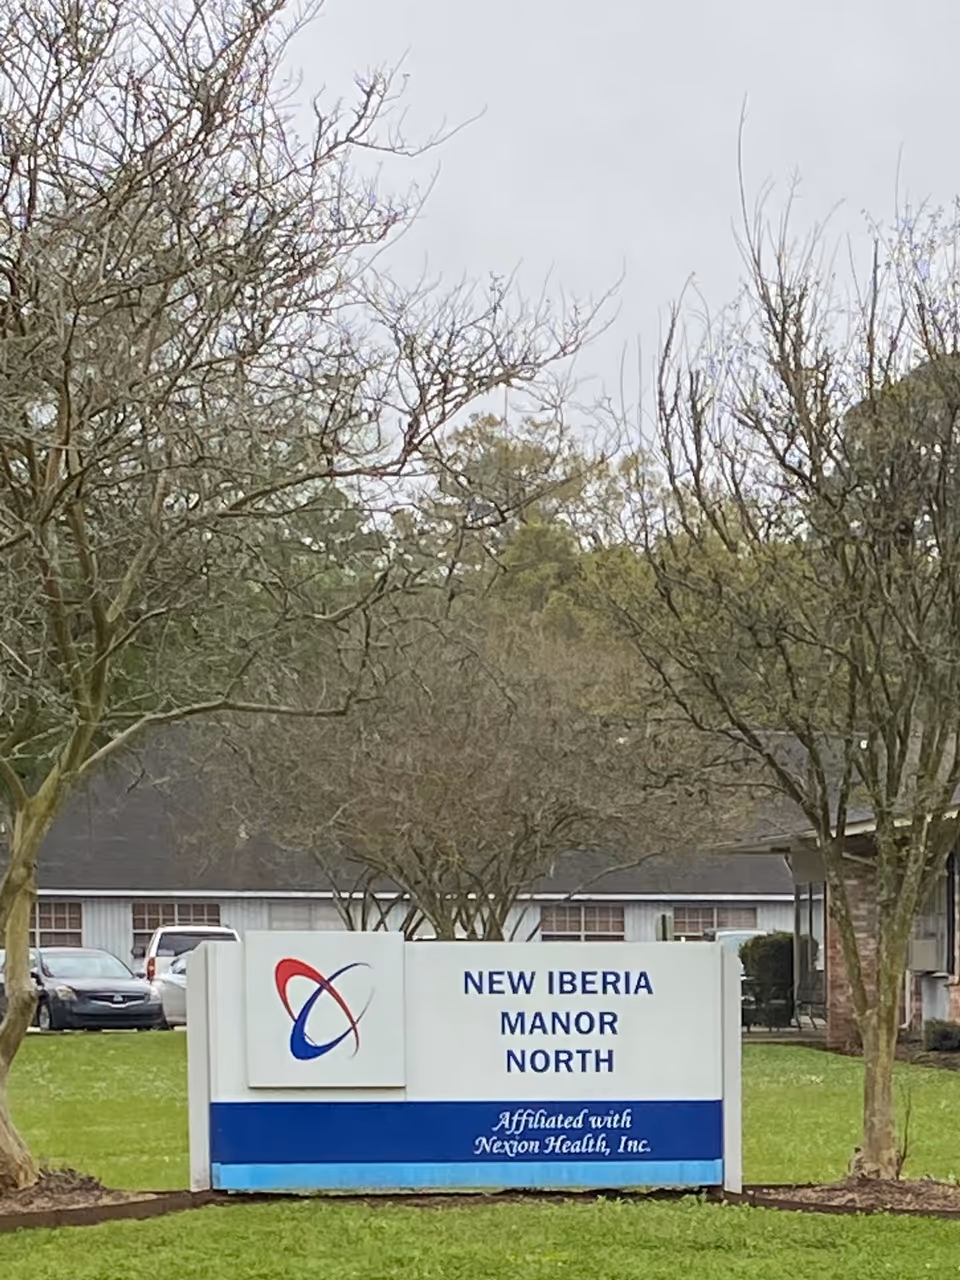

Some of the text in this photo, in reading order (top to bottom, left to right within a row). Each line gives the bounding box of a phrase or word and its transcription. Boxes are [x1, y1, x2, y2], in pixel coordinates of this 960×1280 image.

[463, 970, 654, 995] NEW IBERIA
[501, 1011, 619, 1035] MANOR
[506, 1049, 615, 1073] NORTH
[492, 1109, 632, 1134] Affiliated with
[474, 1134, 651, 1157] Nexion Health, Inc.
